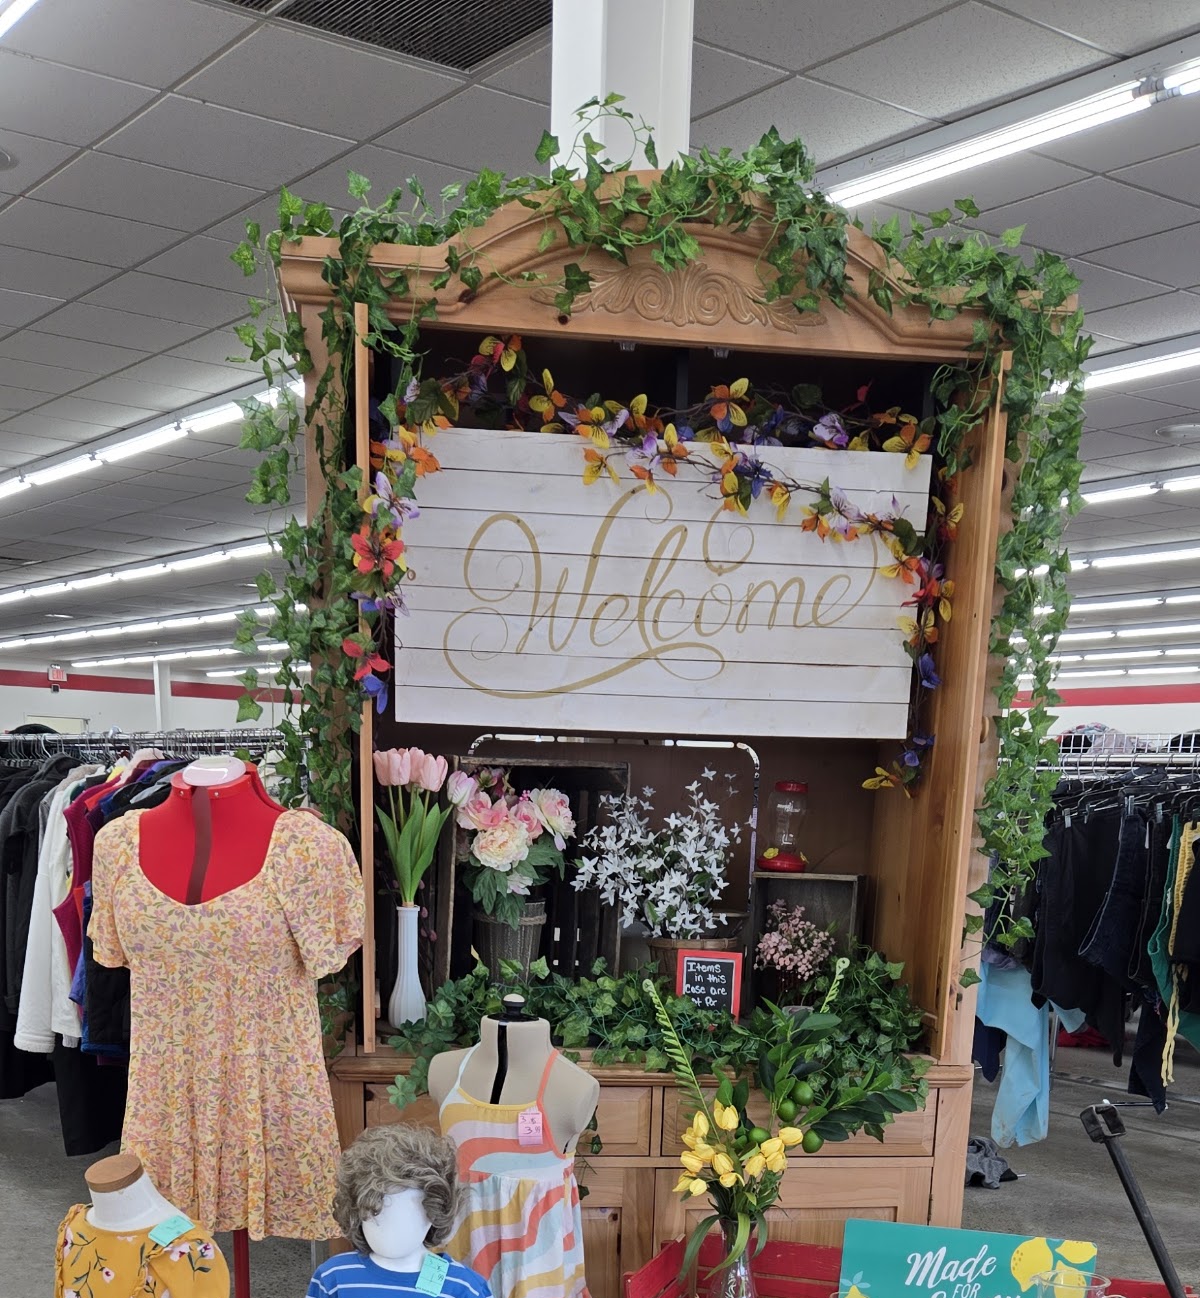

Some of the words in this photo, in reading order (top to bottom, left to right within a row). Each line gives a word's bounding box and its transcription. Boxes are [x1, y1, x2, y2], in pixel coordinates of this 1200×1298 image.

[442, 483, 880, 699] Welcome
[687, 962, 721, 973] Items
[694, 973, 704, 982] in
[706, 974, 727, 984] this
[710, 987, 727, 996] are
[904, 1244, 997, 1289] Made
